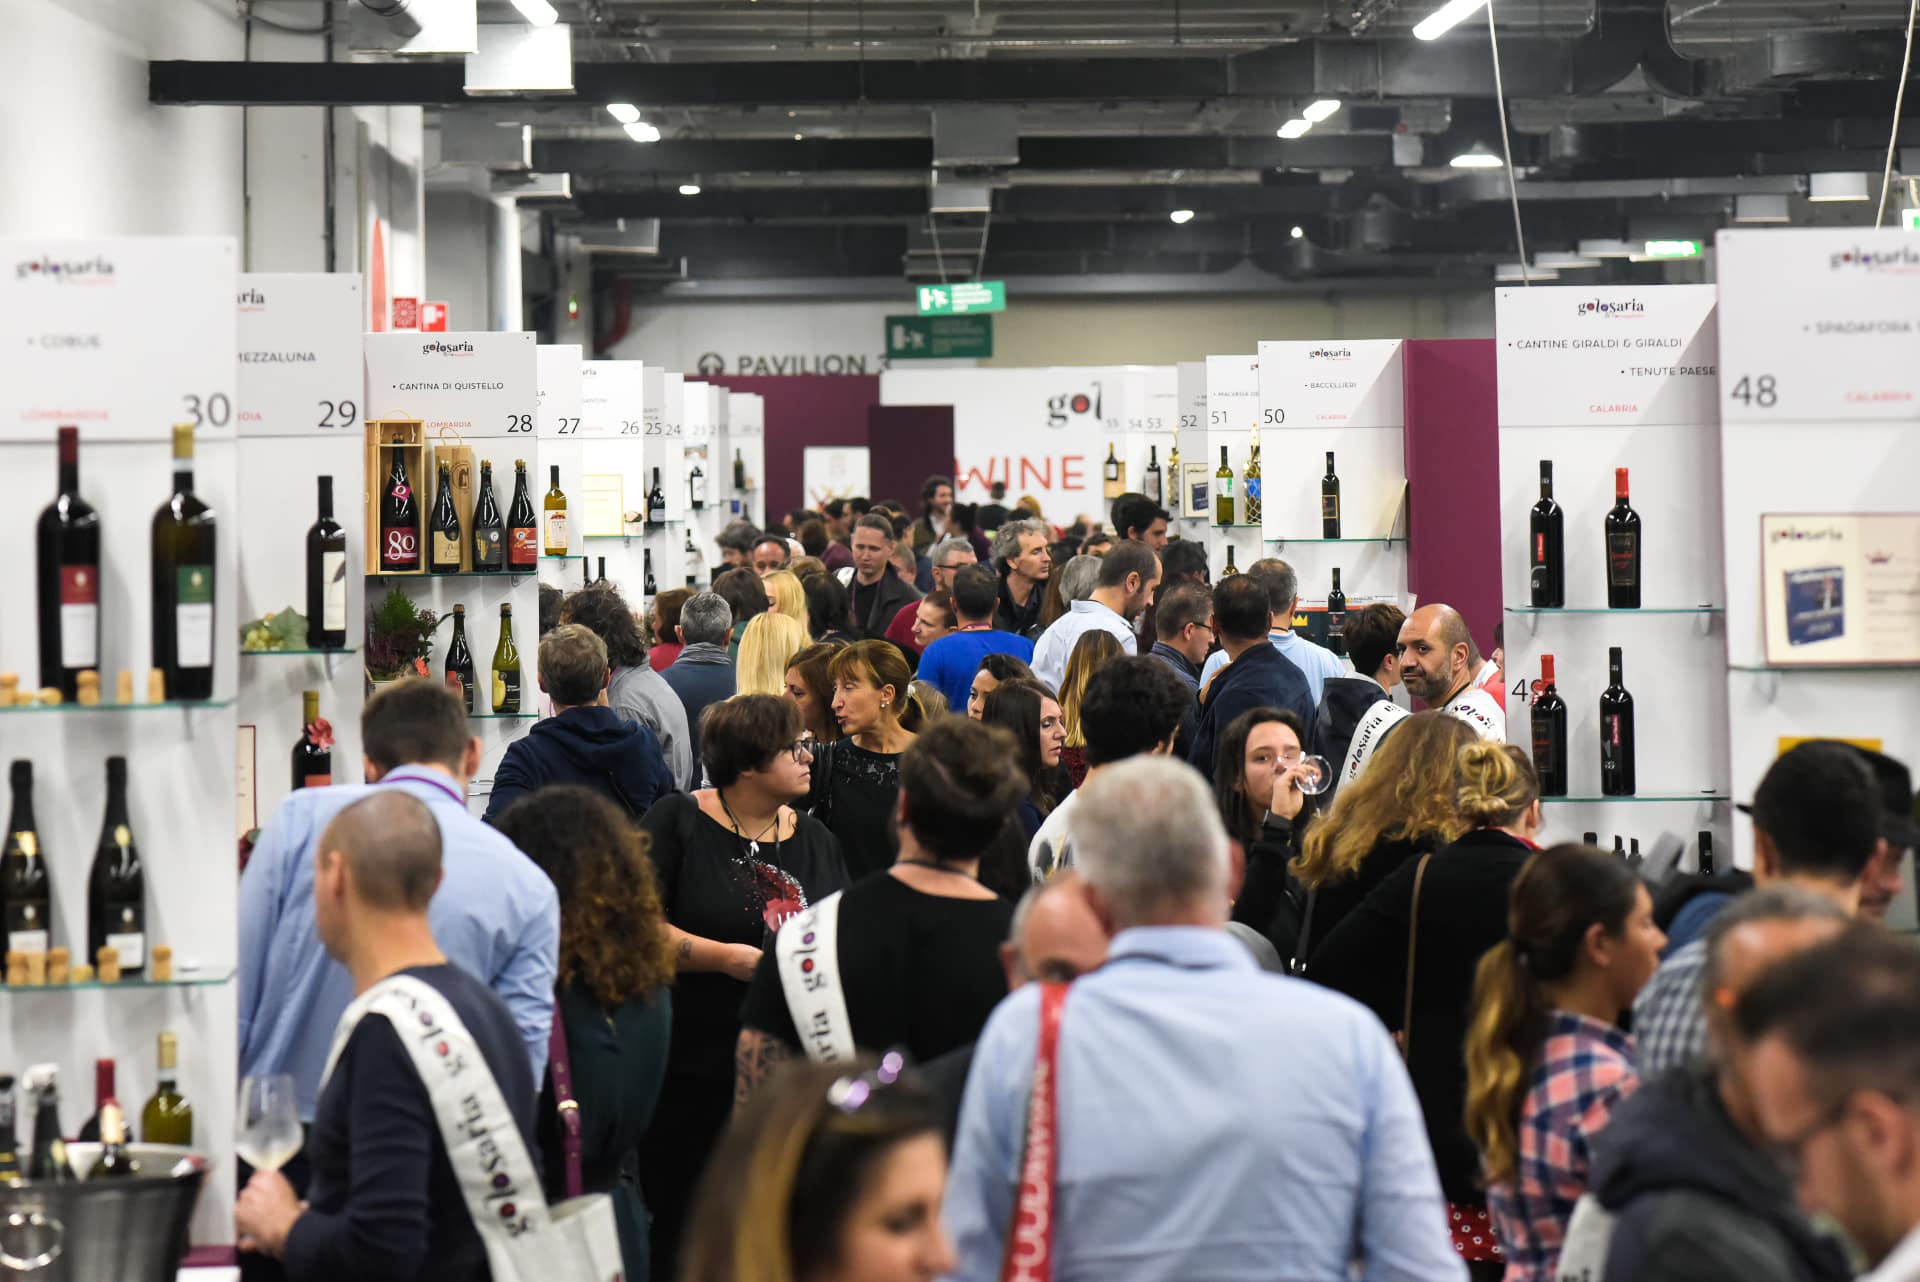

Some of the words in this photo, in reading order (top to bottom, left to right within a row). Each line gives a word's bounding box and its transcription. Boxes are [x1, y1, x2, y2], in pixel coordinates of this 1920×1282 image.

[1578, 298, 1645, 316] golosaria
[422, 340, 474, 355] golosaria
[1516, 339, 1569, 350] CANTINE
[1572, 338, 1619, 349] GIRALDI
[1635, 337, 1682, 348] GIRALDI
[1309, 347, 1351, 359] golosaria
[737, 353, 867, 376] PAVILION
[1630, 366, 1677, 377] TENUTE
[1680, 366, 1717, 377] PAESE
[399, 383, 440, 391] CANTINA
[442, 382, 452, 390] DI
[455, 382, 504, 391] QUISTELLO
[1309, 382, 1357, 390] BACCELLIERI
[1731, 374, 1779, 409] 48
[180, 392, 231, 428] 30
[317, 400, 357, 429] 29
[1263, 408, 1285, 424] 50
[1589, 404, 1639, 414] CALABRIA
[506, 414, 533, 433] 28
[1147, 416, 1162, 429] 53
[1180, 415, 1198, 428] 52
[1210, 410, 1228, 425] 51
[557, 417, 581, 435] 27
[620, 420, 640, 435] 26
[644, 422, 663, 435] 25
[664, 423, 681, 436] 24
[952, 454, 1086, 492] WINE
